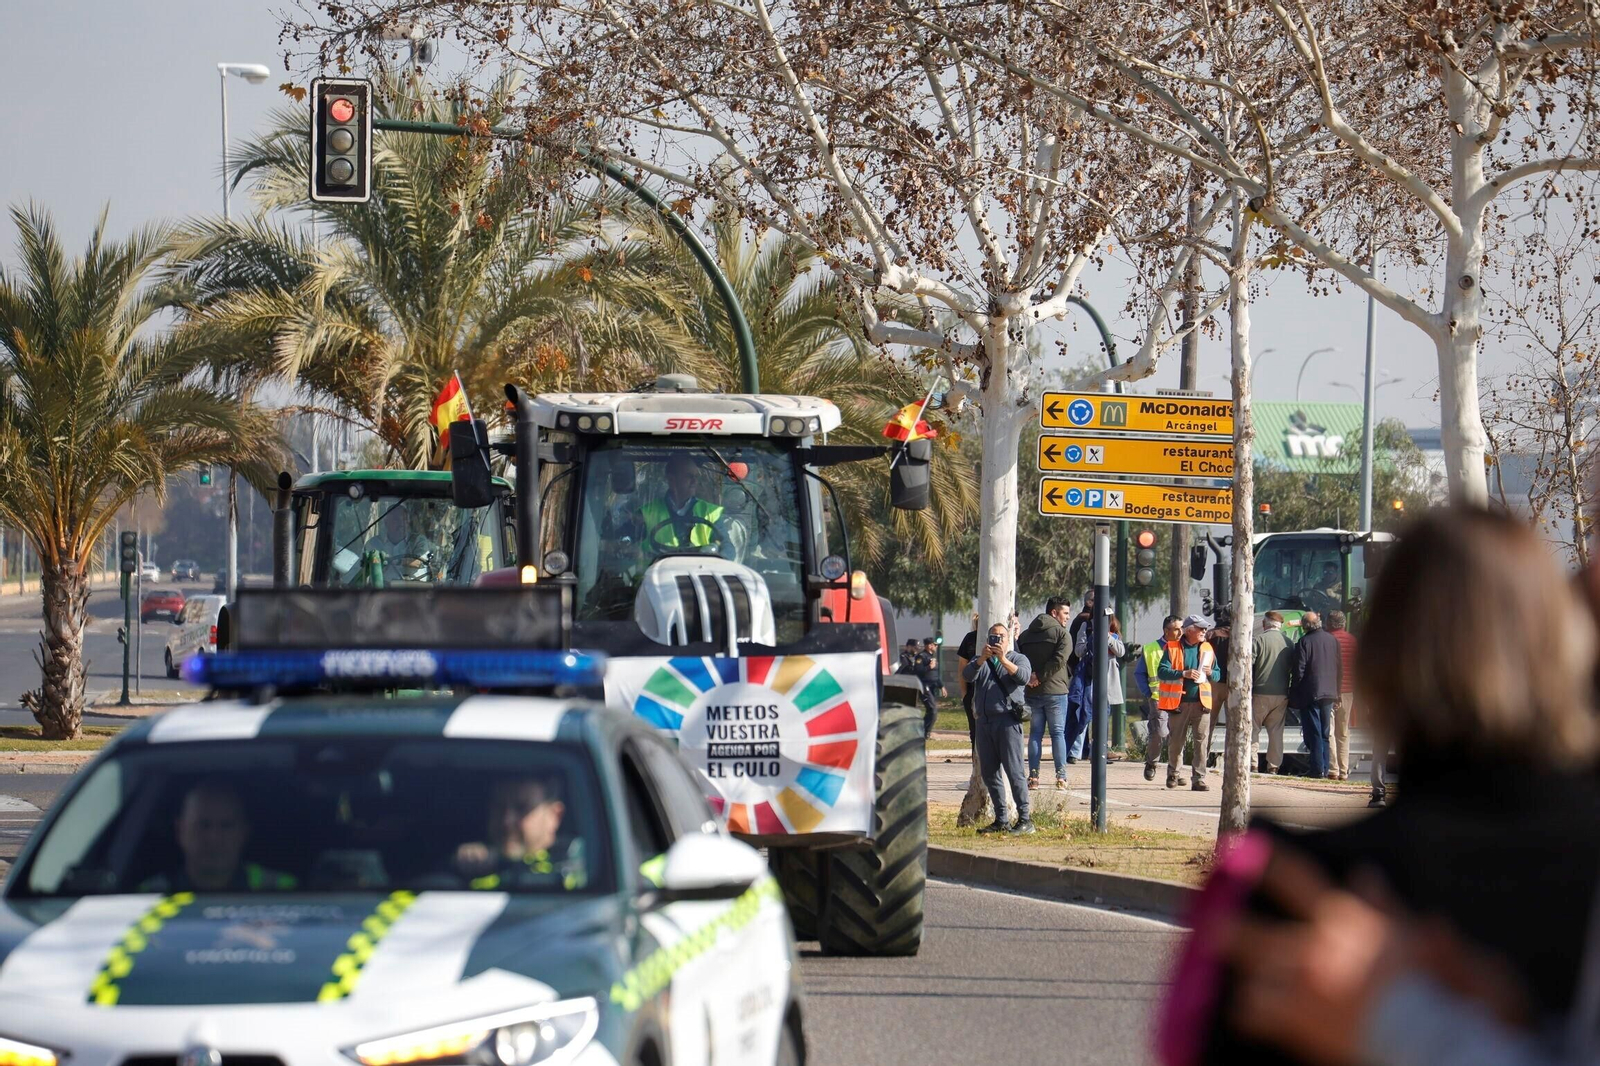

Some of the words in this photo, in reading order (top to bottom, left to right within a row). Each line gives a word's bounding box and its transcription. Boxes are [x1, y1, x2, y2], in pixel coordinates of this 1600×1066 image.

[664, 418, 723, 430] STEYR
[1166, 420, 1217, 432] Arcángel
[1163, 446, 1234, 459] restaurant
[1180, 460, 1194, 472] El
[1199, 461, 1234, 474] Choc
[1162, 491, 1234, 505] restaurant
[1125, 503, 1181, 519] Bodegas
[1185, 507, 1234, 521] Campo
[707, 705, 779, 721] METEOS
[706, 723, 780, 740] VUESTRA
[710, 744, 752, 757] AGENDA
[753, 743, 778, 756] POR
[707, 762, 727, 779] EL
[733, 761, 780, 778] CULO
